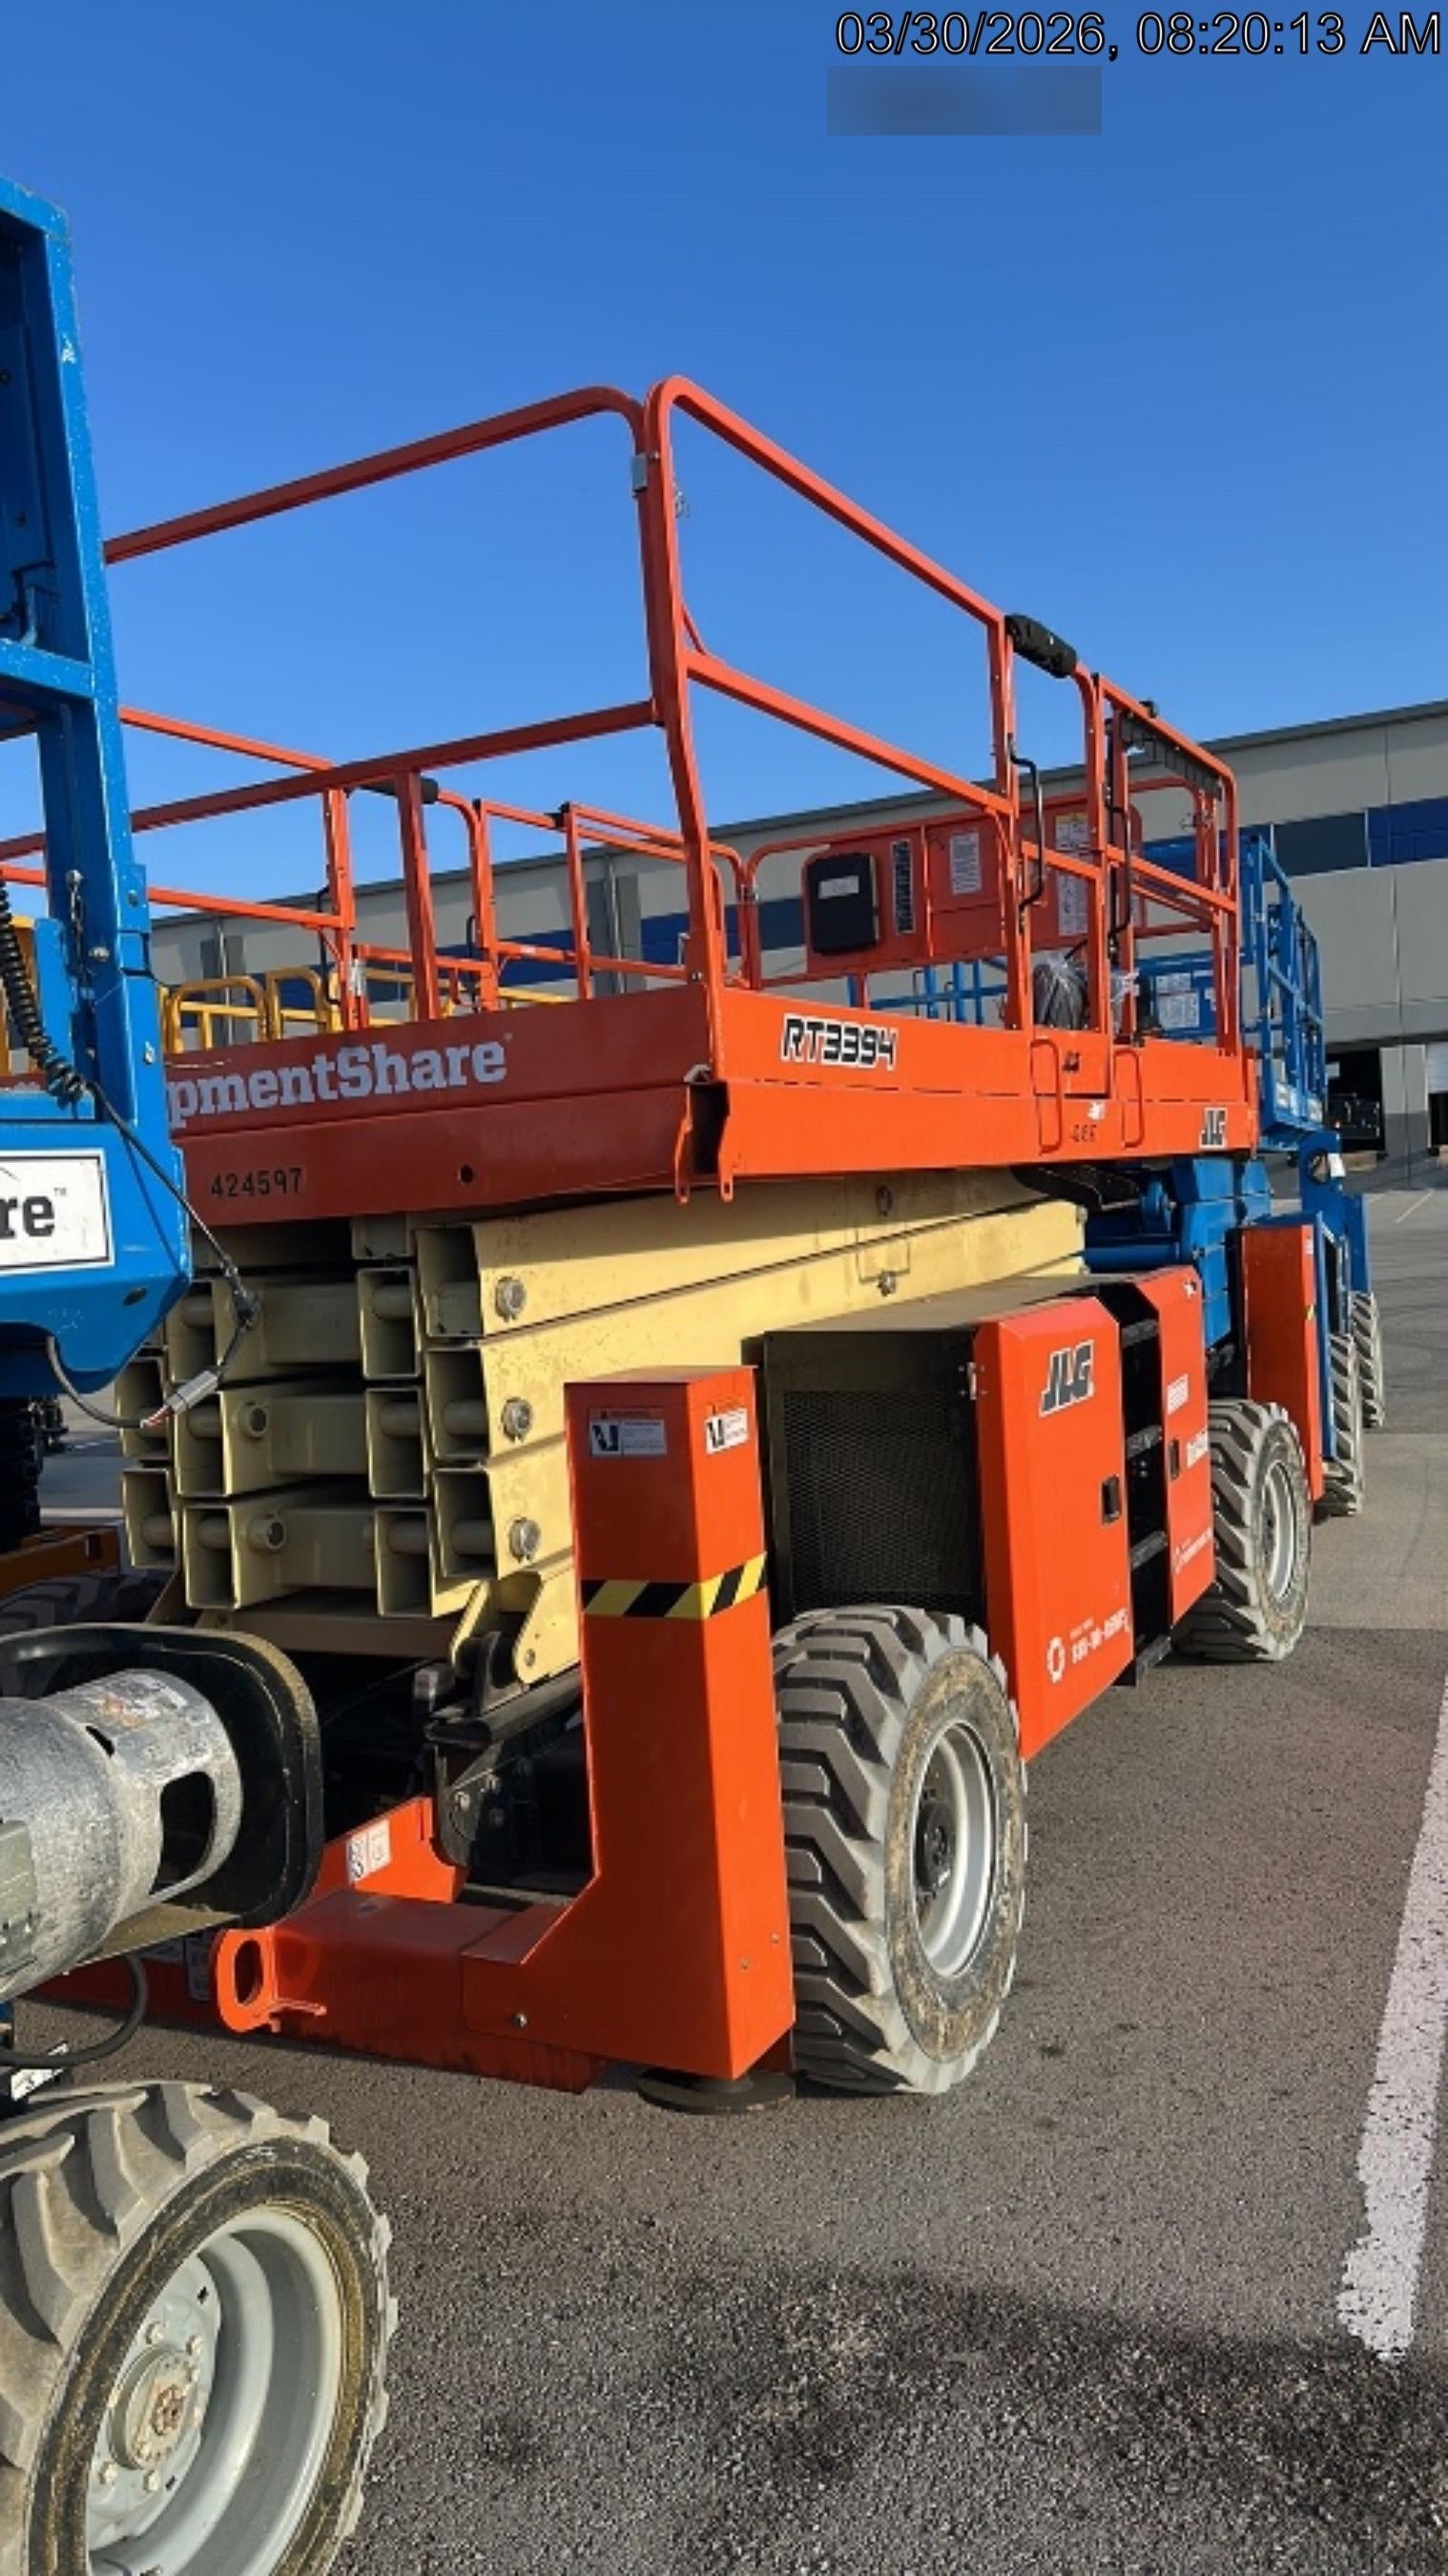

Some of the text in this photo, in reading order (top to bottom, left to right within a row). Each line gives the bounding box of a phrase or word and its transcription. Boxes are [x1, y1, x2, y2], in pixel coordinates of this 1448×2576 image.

[781, 1013, 899, 1070] RT3394
[211, 1167, 301, 1198] 424597
[1038, 1340, 1094, 1418] JLG
